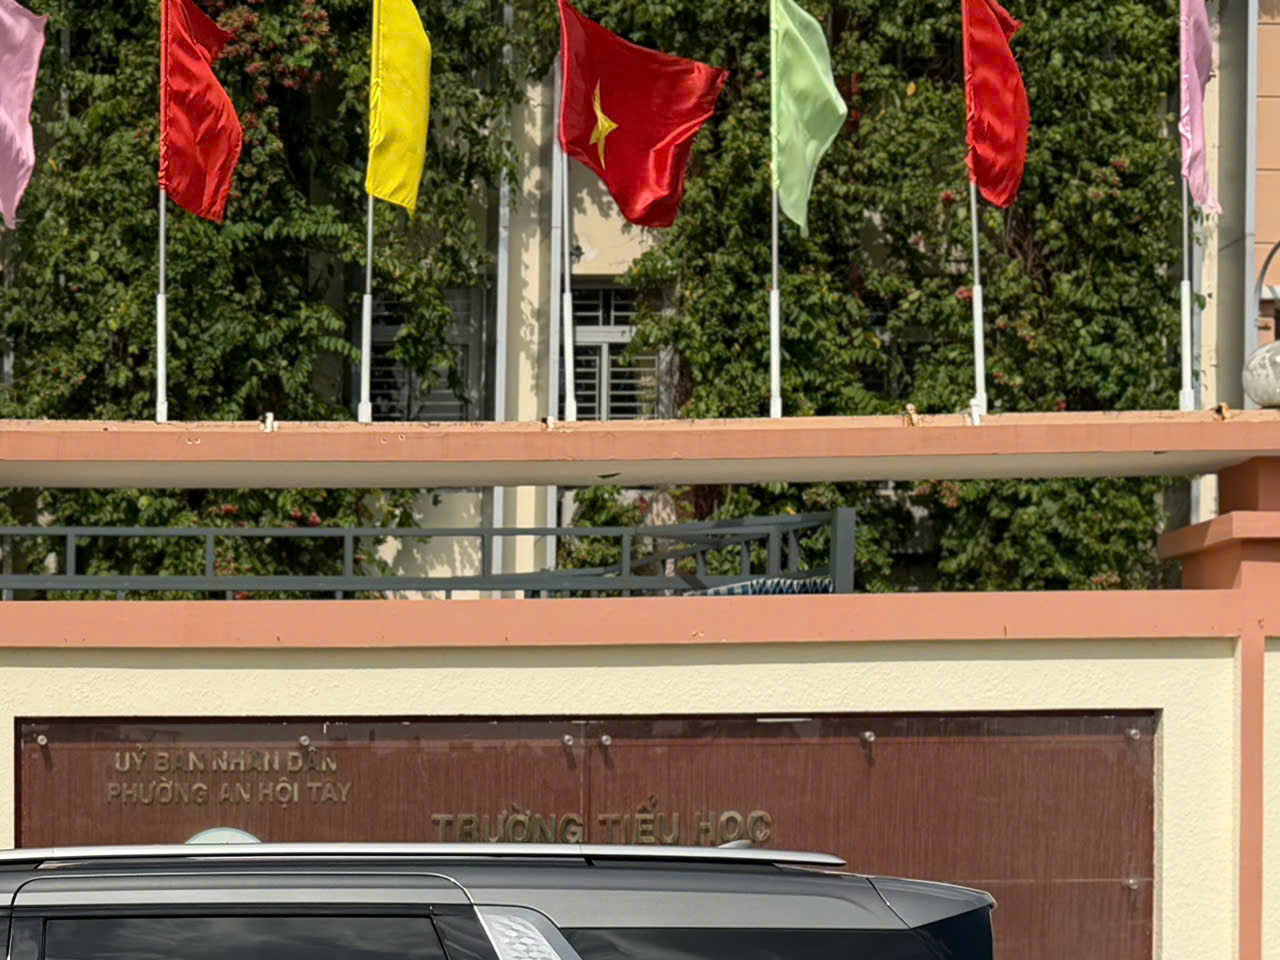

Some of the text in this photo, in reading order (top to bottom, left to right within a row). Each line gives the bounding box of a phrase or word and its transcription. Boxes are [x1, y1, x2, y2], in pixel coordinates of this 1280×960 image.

[108, 777, 352, 808] PHƯỜNG AN HỘI TÂY
[432, 802, 585, 843] TRƯỜNG
[599, 795, 680, 843] TIỂU
